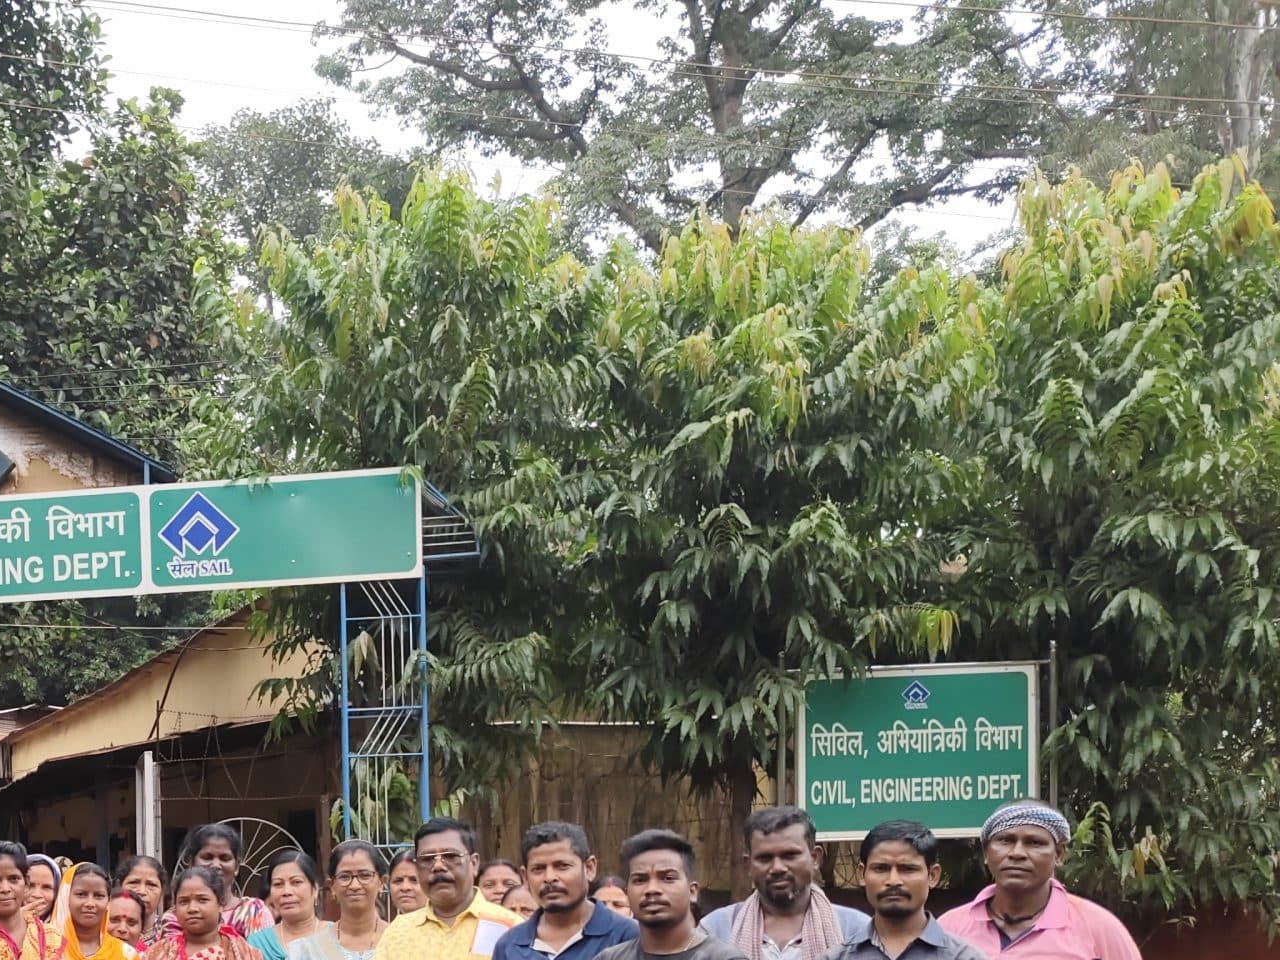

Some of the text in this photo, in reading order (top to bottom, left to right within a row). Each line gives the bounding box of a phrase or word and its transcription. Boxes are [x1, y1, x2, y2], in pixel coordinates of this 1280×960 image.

[46, 505, 126, 541] विभाग
[53, 550, 131, 582] DEPT.
[200, 560, 232, 576] SAIL
[811, 716, 1023, 759] सिविल, अभियांत्रिकी विभाग
[811, 774, 1023, 808] CIVIL, ENGINEERING DEPT.
